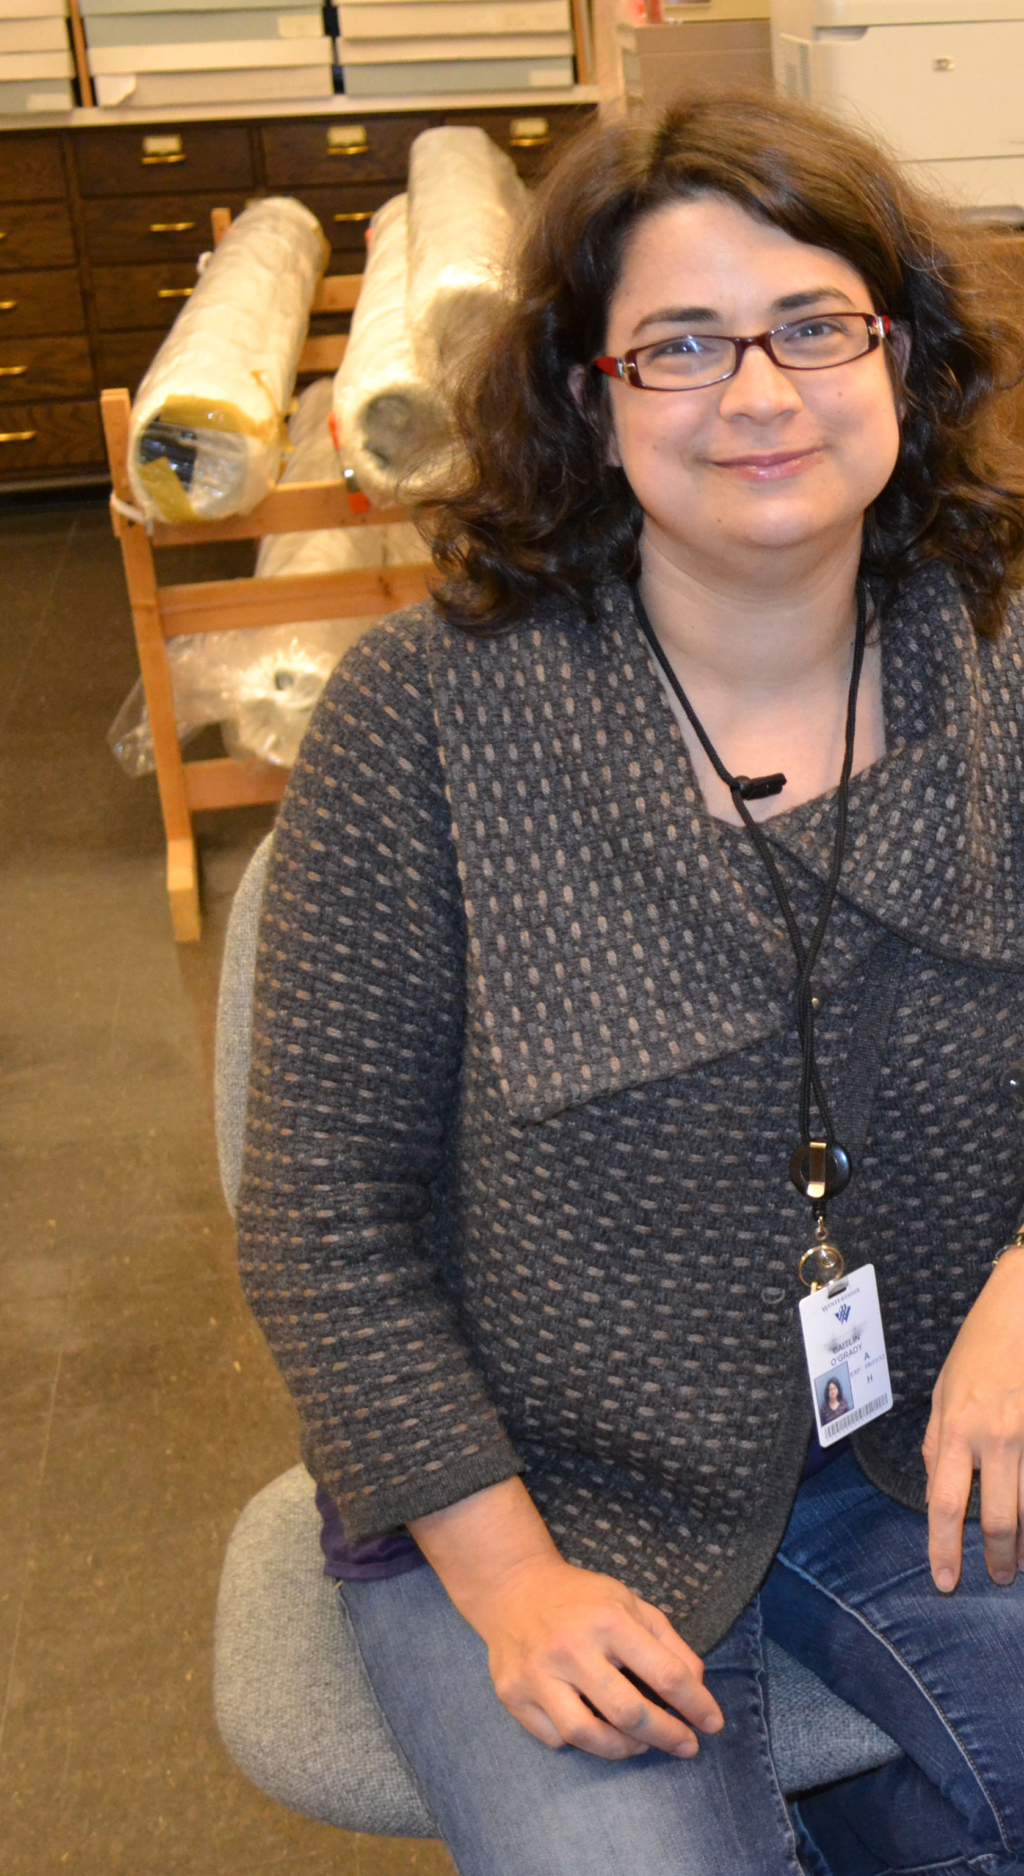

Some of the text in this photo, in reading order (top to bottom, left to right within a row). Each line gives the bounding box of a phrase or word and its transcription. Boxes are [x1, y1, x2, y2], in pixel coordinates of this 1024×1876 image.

[832, 1333, 861, 1354] CAITLIN
[830, 1343, 863, 1366] O'GRADY
[864, 1352, 870, 1361] A
[866, 1374, 873, 1384] H
